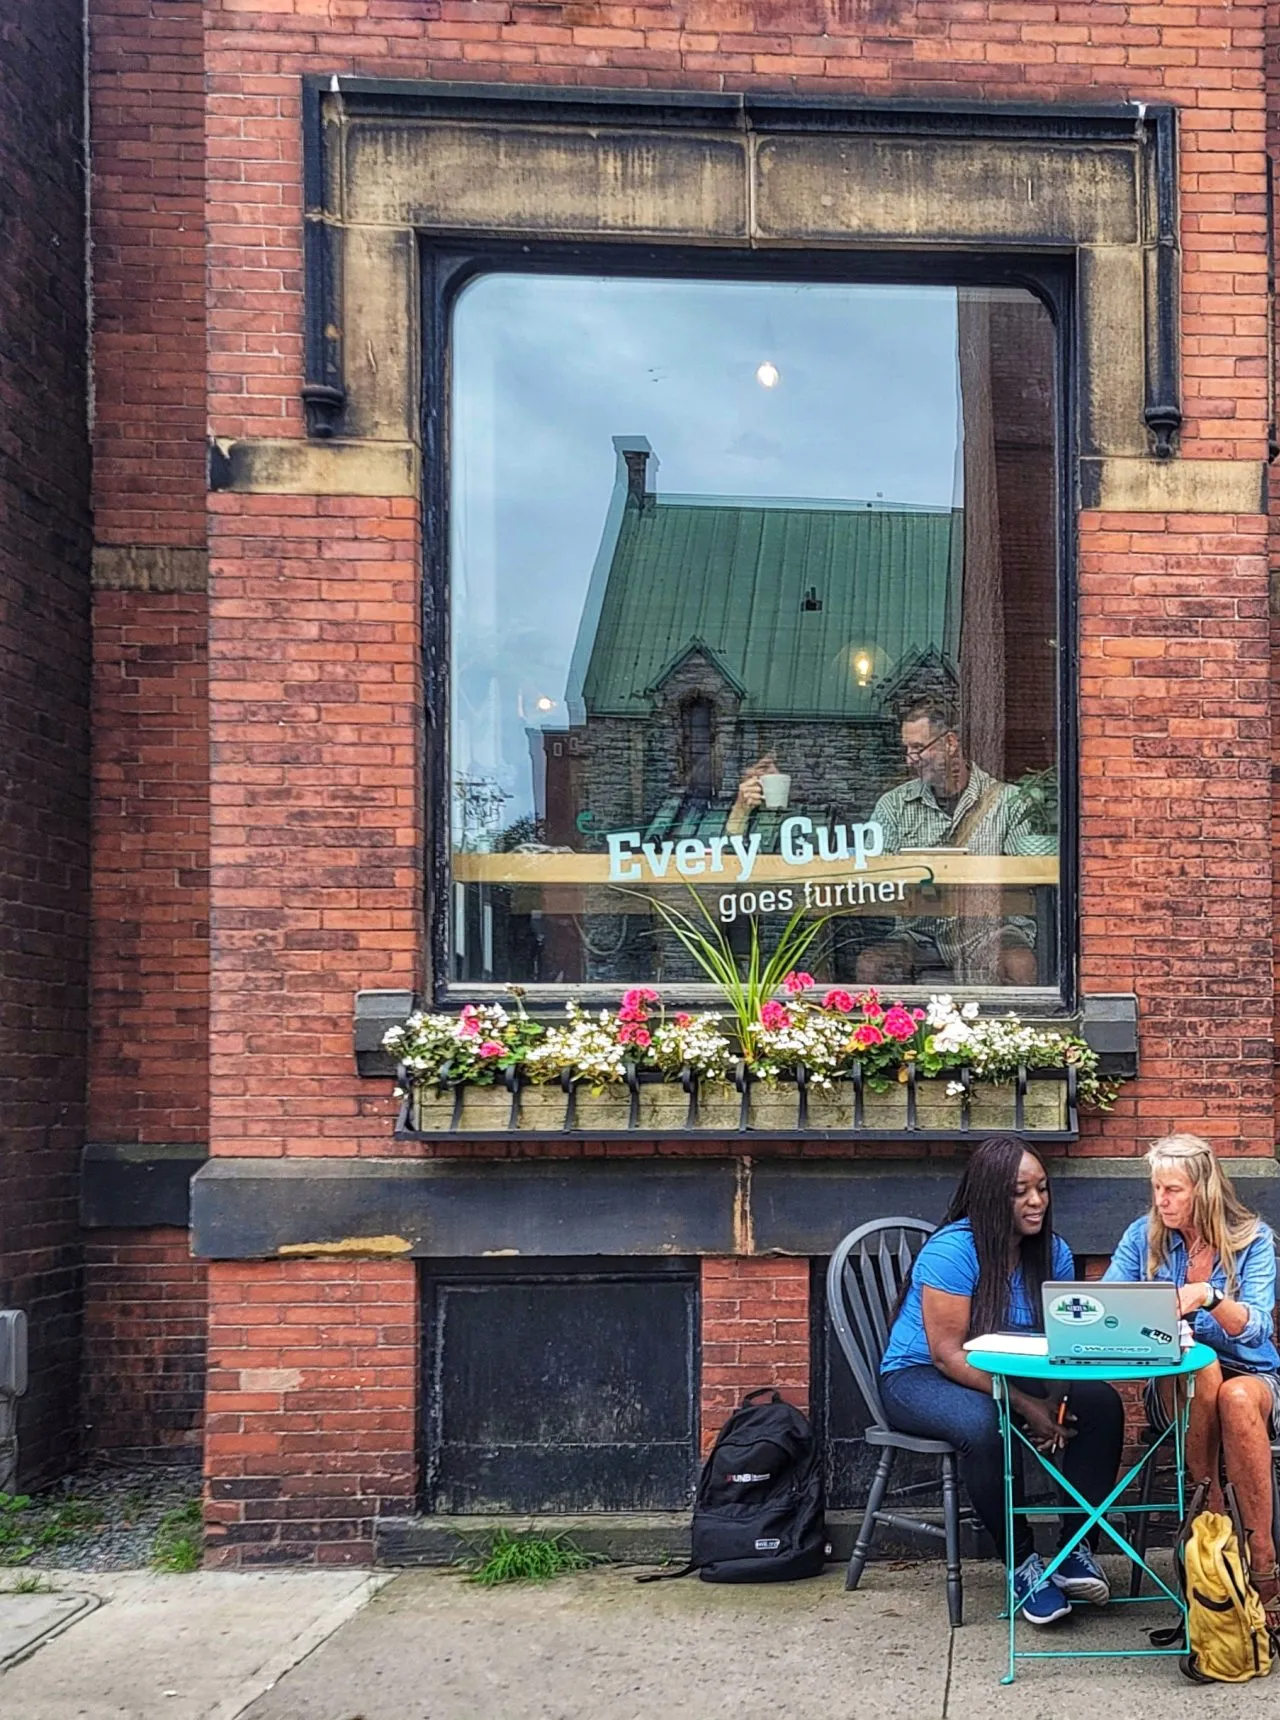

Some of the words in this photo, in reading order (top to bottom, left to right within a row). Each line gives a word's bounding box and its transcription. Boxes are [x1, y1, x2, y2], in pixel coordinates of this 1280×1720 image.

[606, 831, 762, 882] Every
[780, 816, 884, 870] Cup
[719, 888, 793, 922] goes
[803, 878, 907, 910] further
